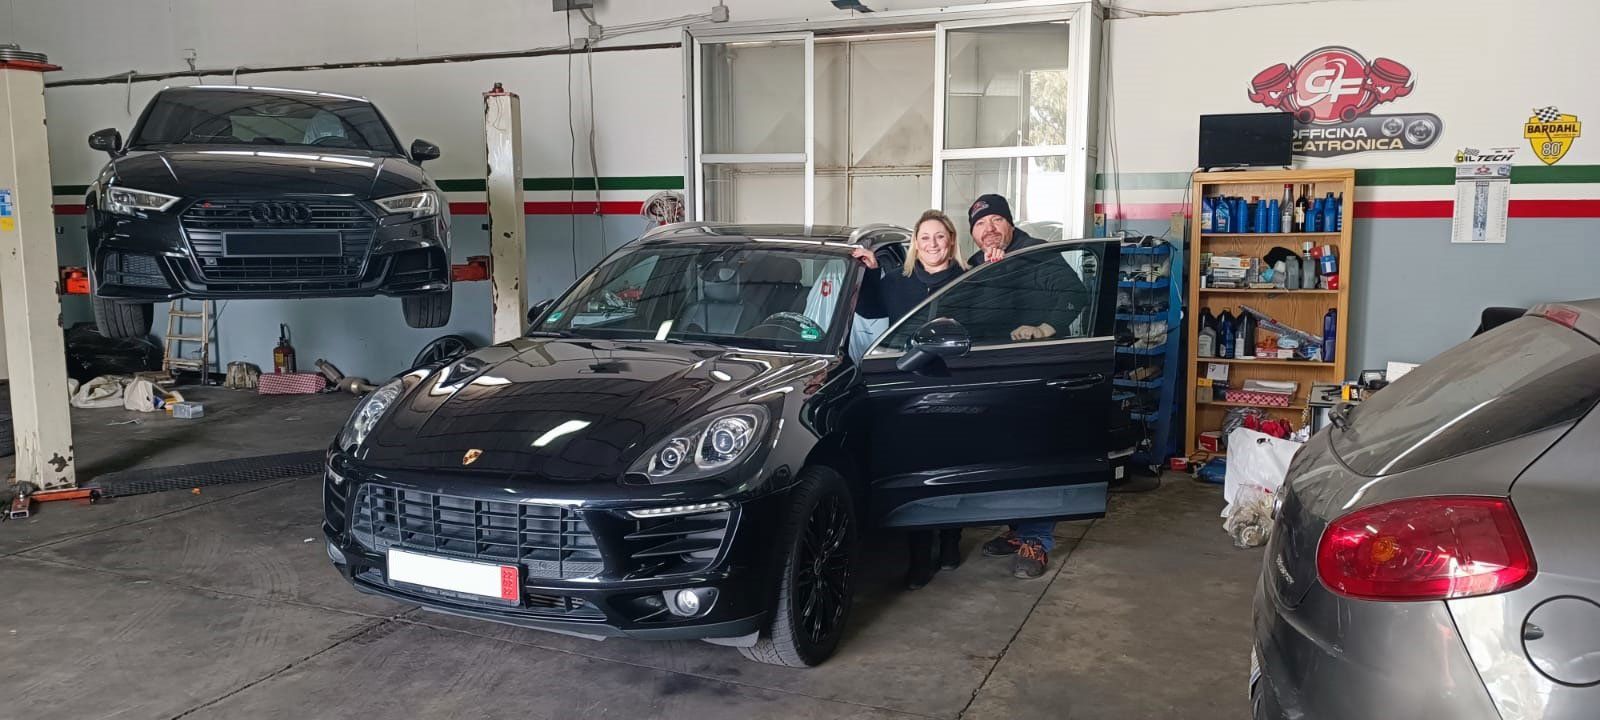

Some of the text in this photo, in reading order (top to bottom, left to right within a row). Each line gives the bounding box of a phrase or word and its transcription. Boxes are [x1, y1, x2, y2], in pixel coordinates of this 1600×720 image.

[1298, 58, 1363, 106] GF
[1527, 124, 1578, 133] BARDAHL
[1477, 154, 1513, 162] TECH
